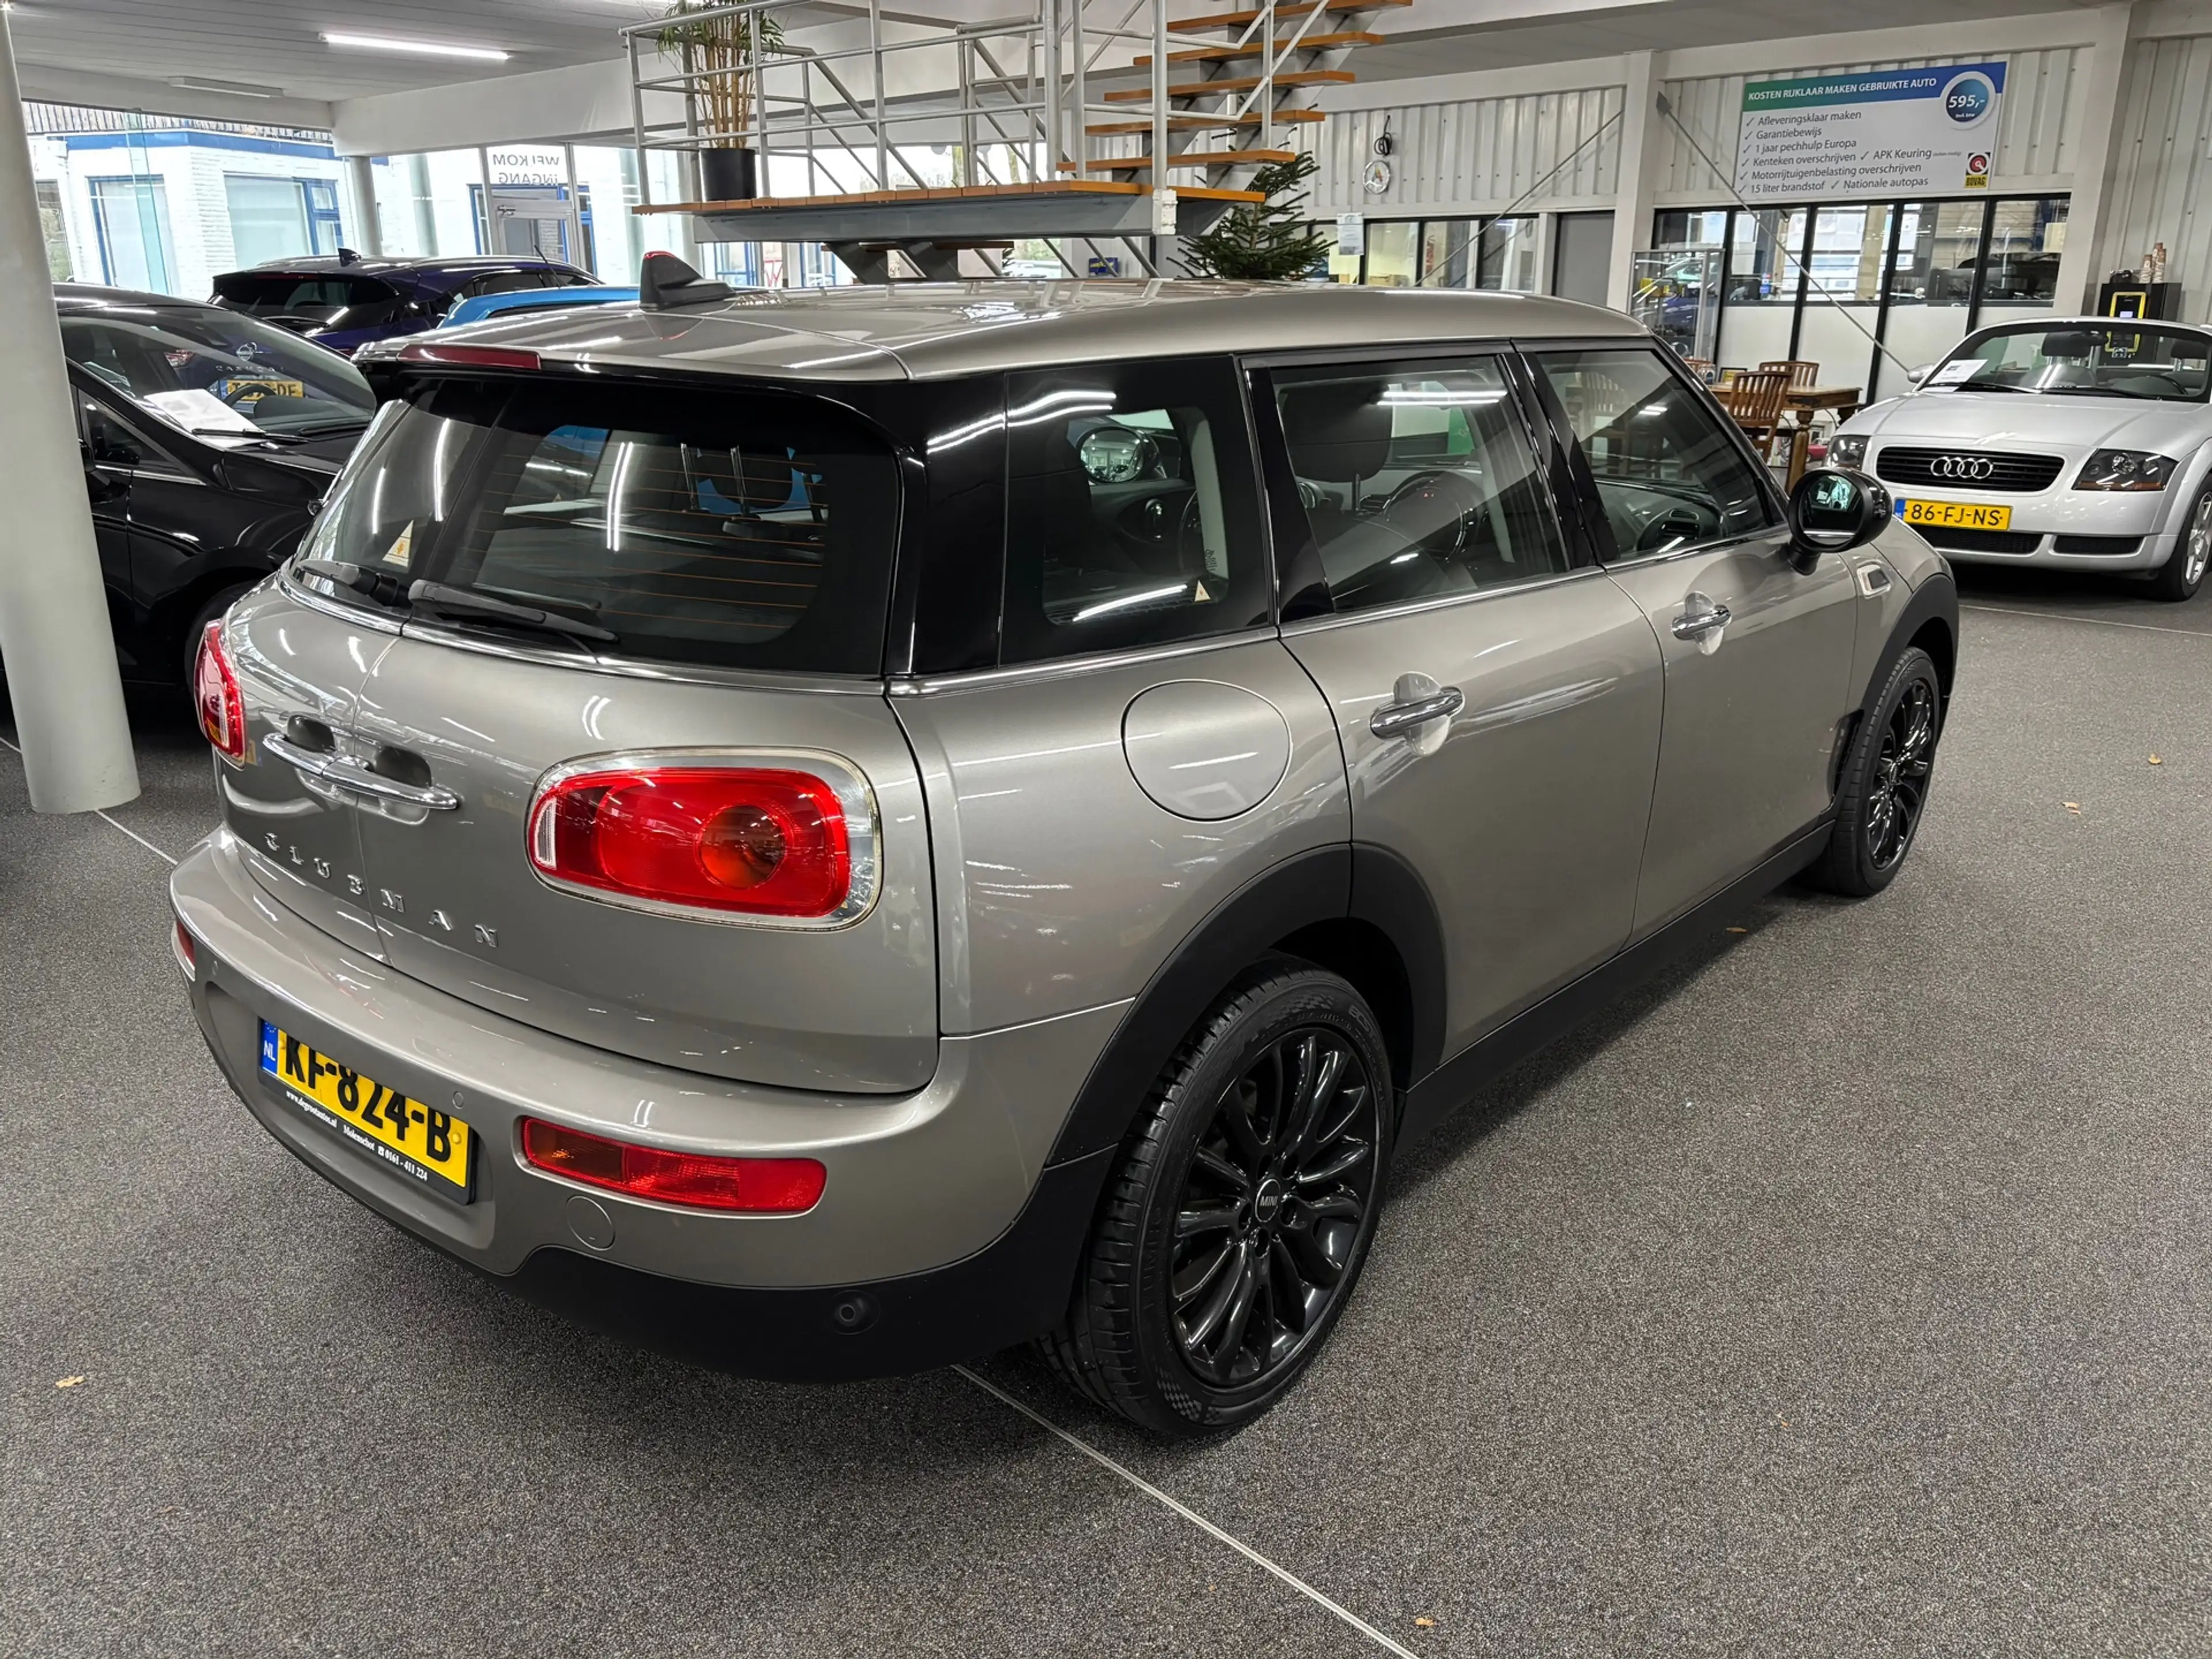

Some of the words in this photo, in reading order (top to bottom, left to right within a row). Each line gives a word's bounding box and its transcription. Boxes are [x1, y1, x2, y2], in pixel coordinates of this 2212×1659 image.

[1748, 90, 1782, 101] KOSTEN
[1783, 86, 1824, 98] RIJKLAAR
[1824, 84, 1857, 94] MAKEN
[1858, 79, 1909, 92] GEBRUIKTE
[1910, 78, 1937, 88] AUTO
[1948, 94, 1986, 109] 595,-
[1758, 113, 1828, 126] Afleveringsklaar
[1830, 111, 1862, 120] maken
[1756, 128, 1822, 139] Garantiebewijs
[1756, 145, 1760, 153] 1
[1760, 145, 1779, 155] jaar
[1779, 141, 1823, 153] pechhulp
[1824, 139, 1857, 150] Europa
[1753, 156, 1794, 166] Kenteken
[1796, 153, 1856, 164] overschrijven
[1873, 150, 1893, 160] APK
[1894, 148, 1932, 160] Keuring
[1751, 166, 1857, 180] Motorrijtuigenbelasting
[1858, 163, 1922, 175] overschrijven
[1751, 185, 1760, 194] 15
[1763, 184, 1780, 193] liter
[1781, 180, 1826, 192] brandstof
[1843, 178, 1888, 189] Nationale
[1889, 177, 1929, 188] autopas
[1965, 176, 1987, 187] BOVAG
[1911, 504, 2001, 526] 86-FJ-NS
[264, 832, 499, 948] CLUBMAN
[263, 1039, 276, 1062] NL
[285, 1034, 452, 1163] KF-824-B
[385, 1152, 399, 1165] 0161
[404, 1161, 416, 1175] 411
[416, 1168, 428, 1181] 224
[1260, 1195, 1279, 1207] MINI
